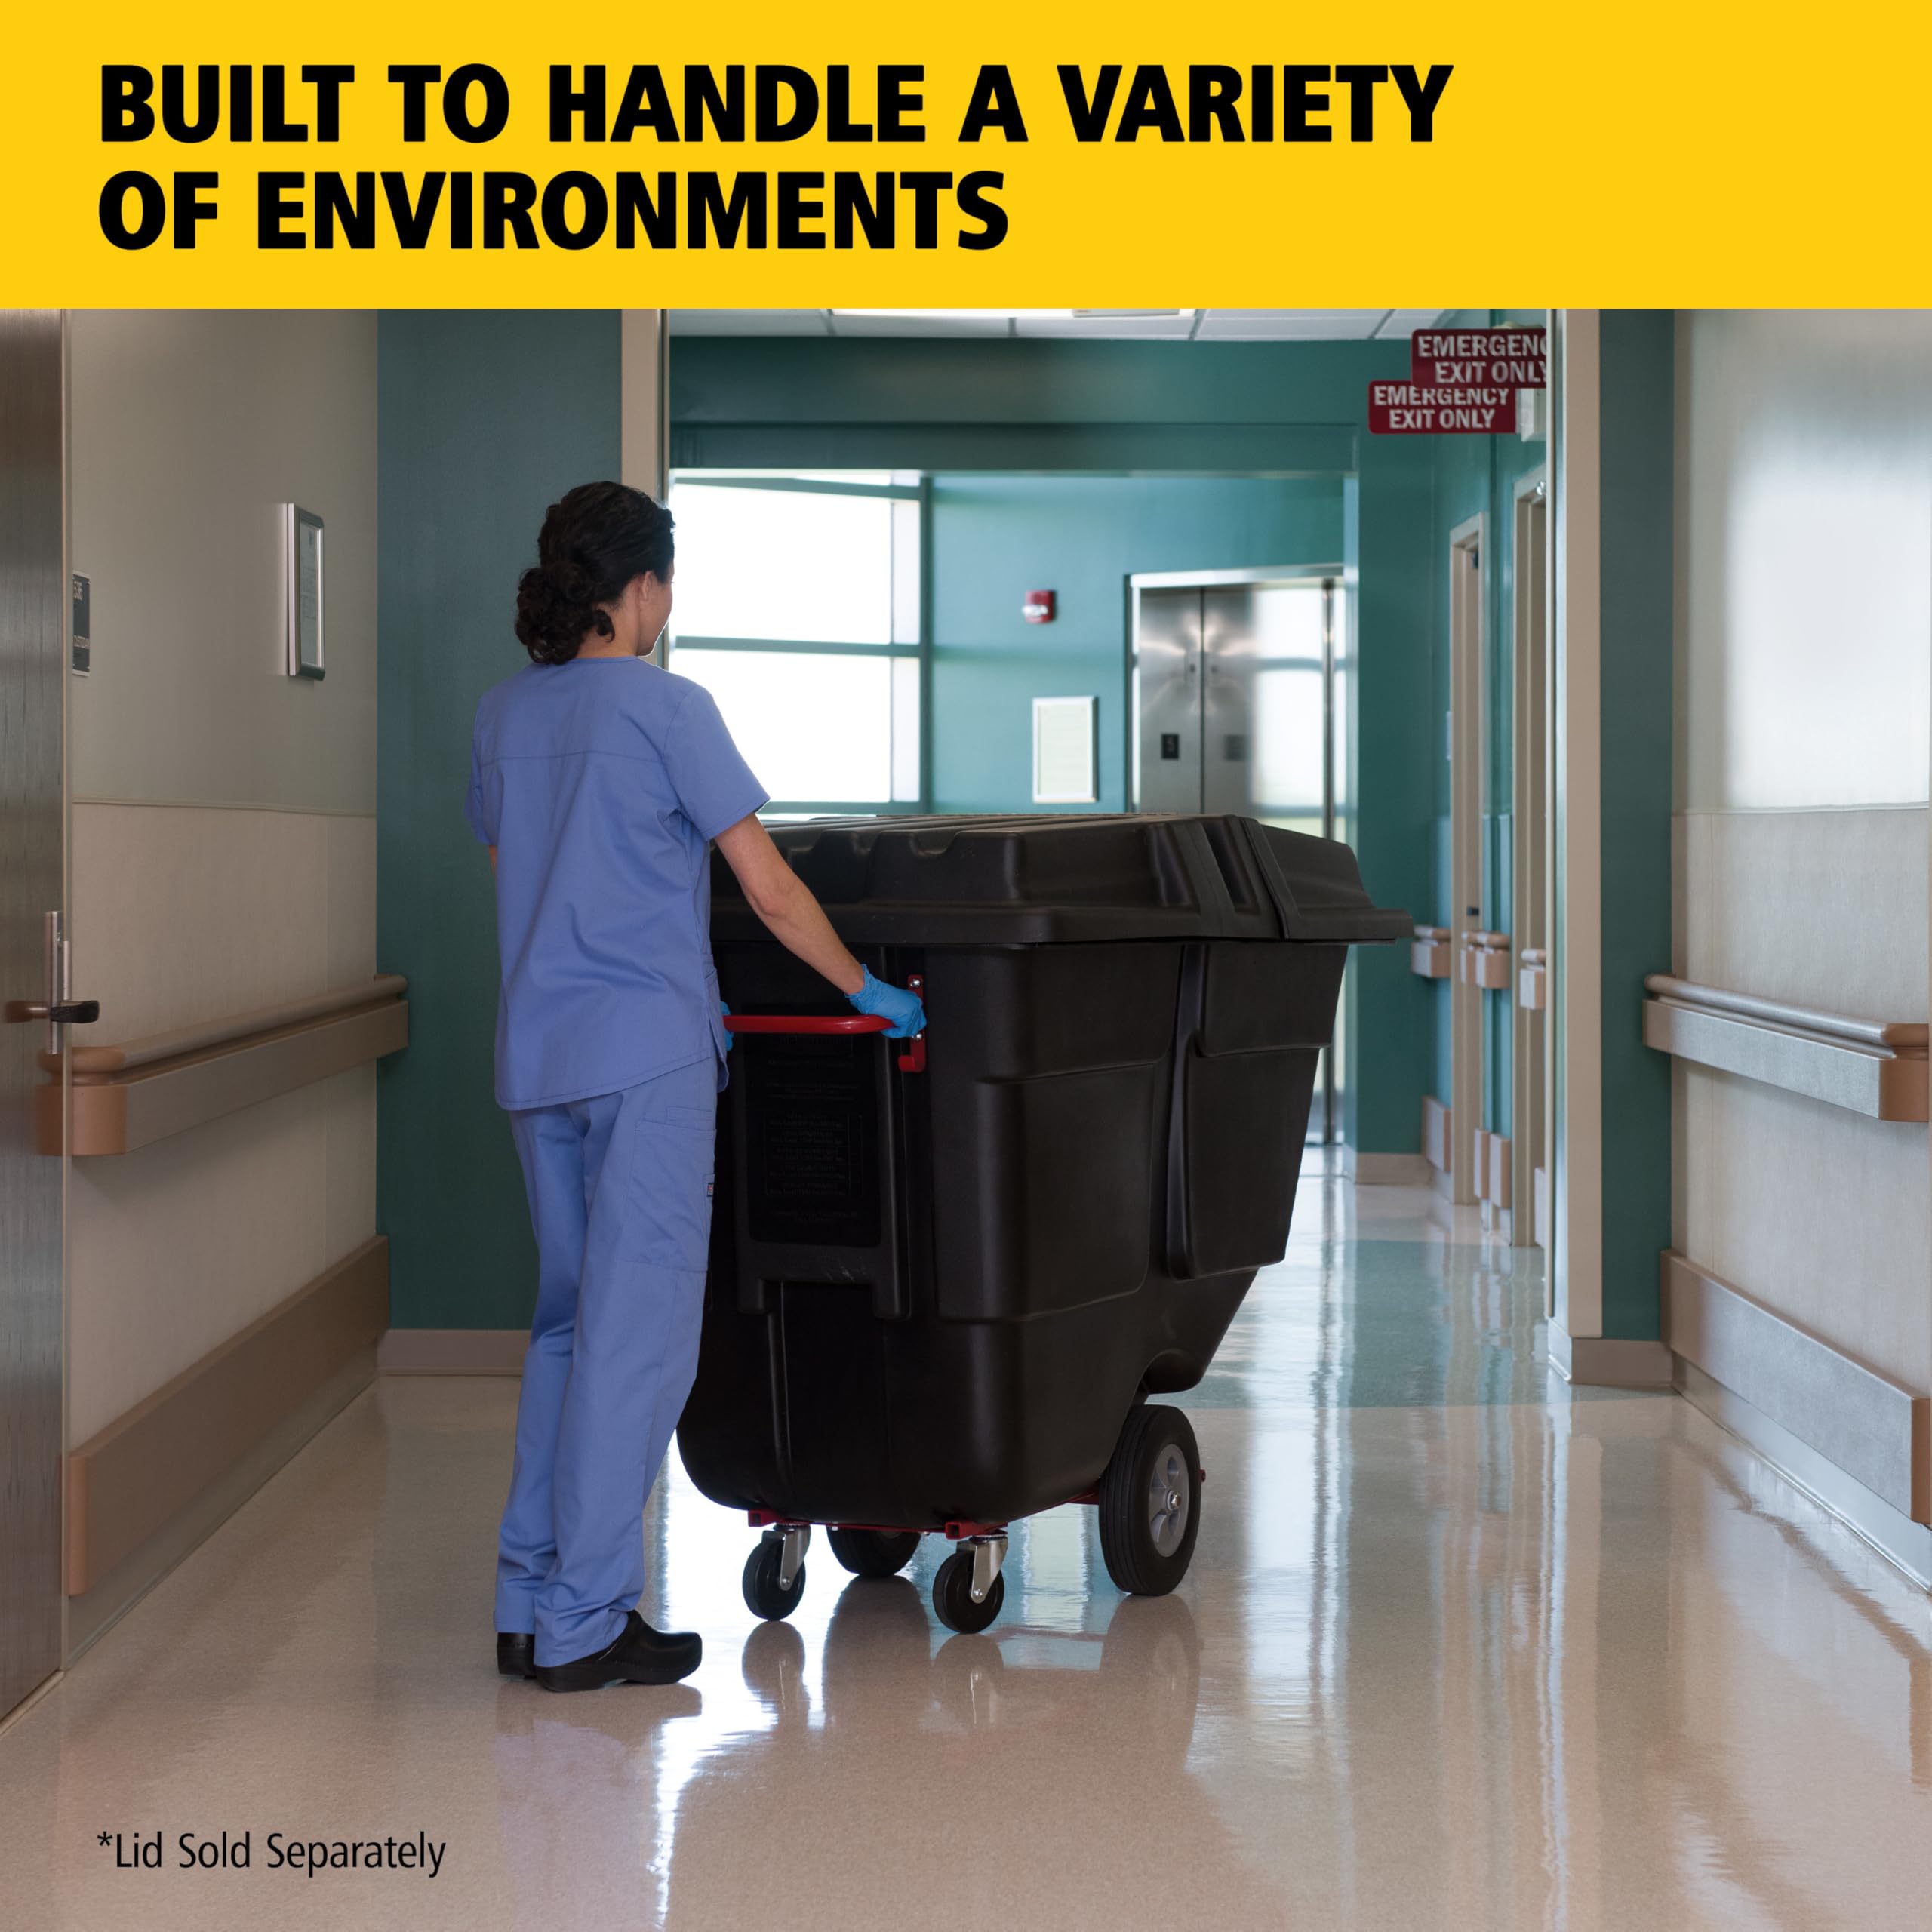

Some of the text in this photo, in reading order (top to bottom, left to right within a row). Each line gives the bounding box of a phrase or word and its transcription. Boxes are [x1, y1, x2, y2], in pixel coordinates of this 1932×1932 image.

[1435, 361, 1486, 383] EXIT
[1374, 386, 1509, 405] EMERGENCY
[1389, 409, 1495, 429] EXIT ONLY
